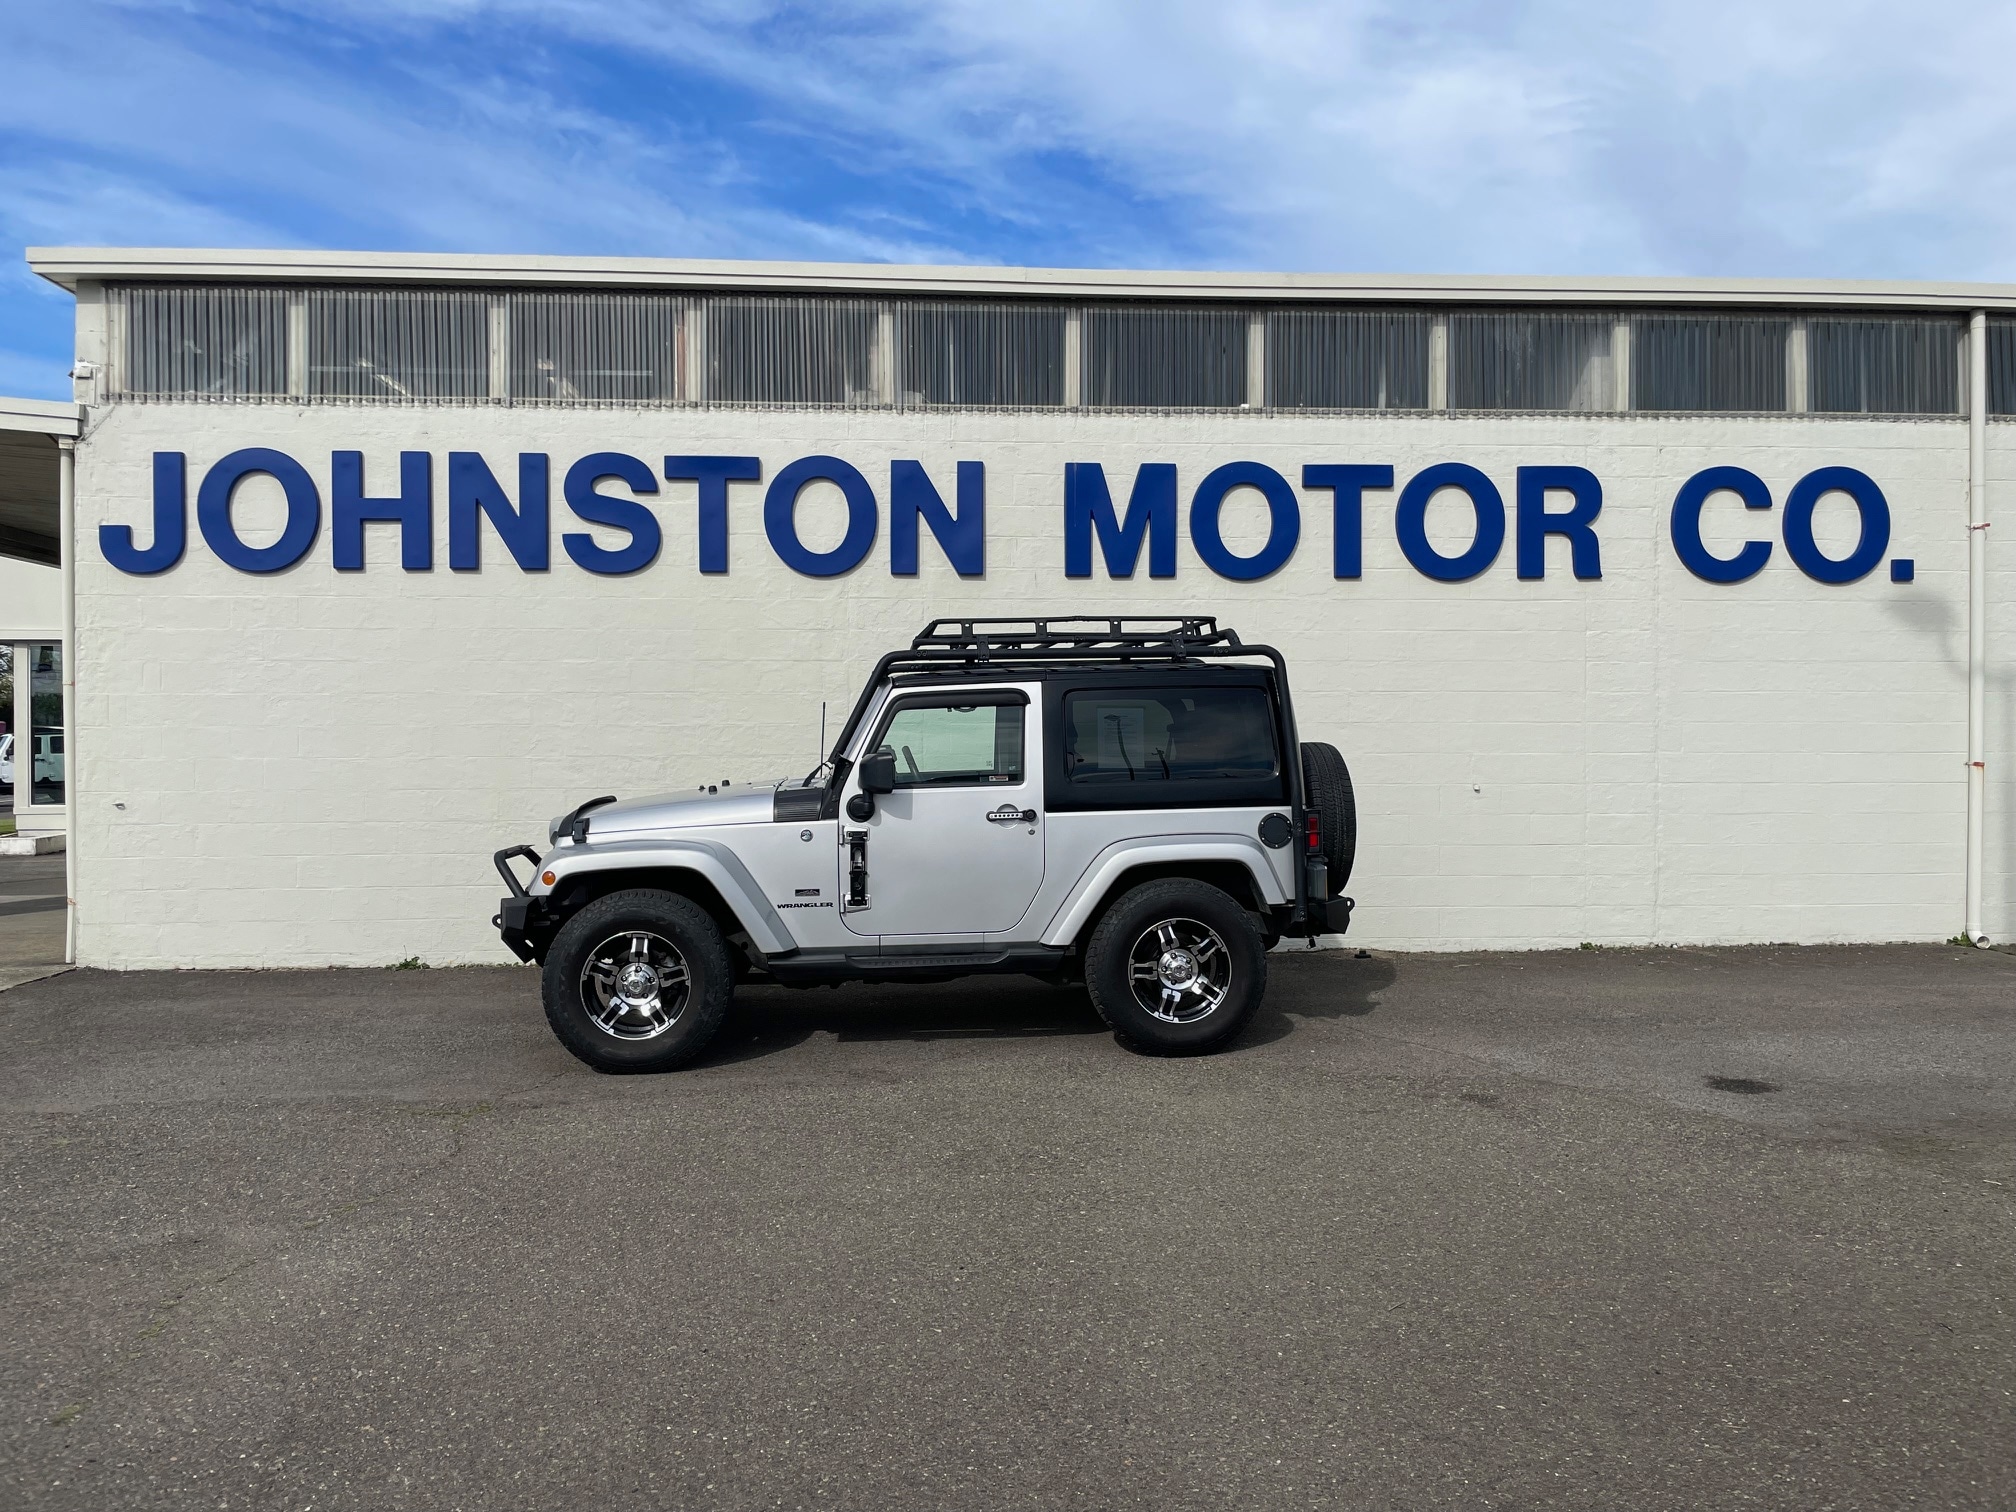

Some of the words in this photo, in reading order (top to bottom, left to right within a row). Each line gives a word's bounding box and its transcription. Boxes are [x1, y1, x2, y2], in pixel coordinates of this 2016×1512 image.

[99, 449, 984, 579] JOHNSTON
[1065, 461, 1604, 582] MOTOR
[1671, 466, 1914, 585] CO.
